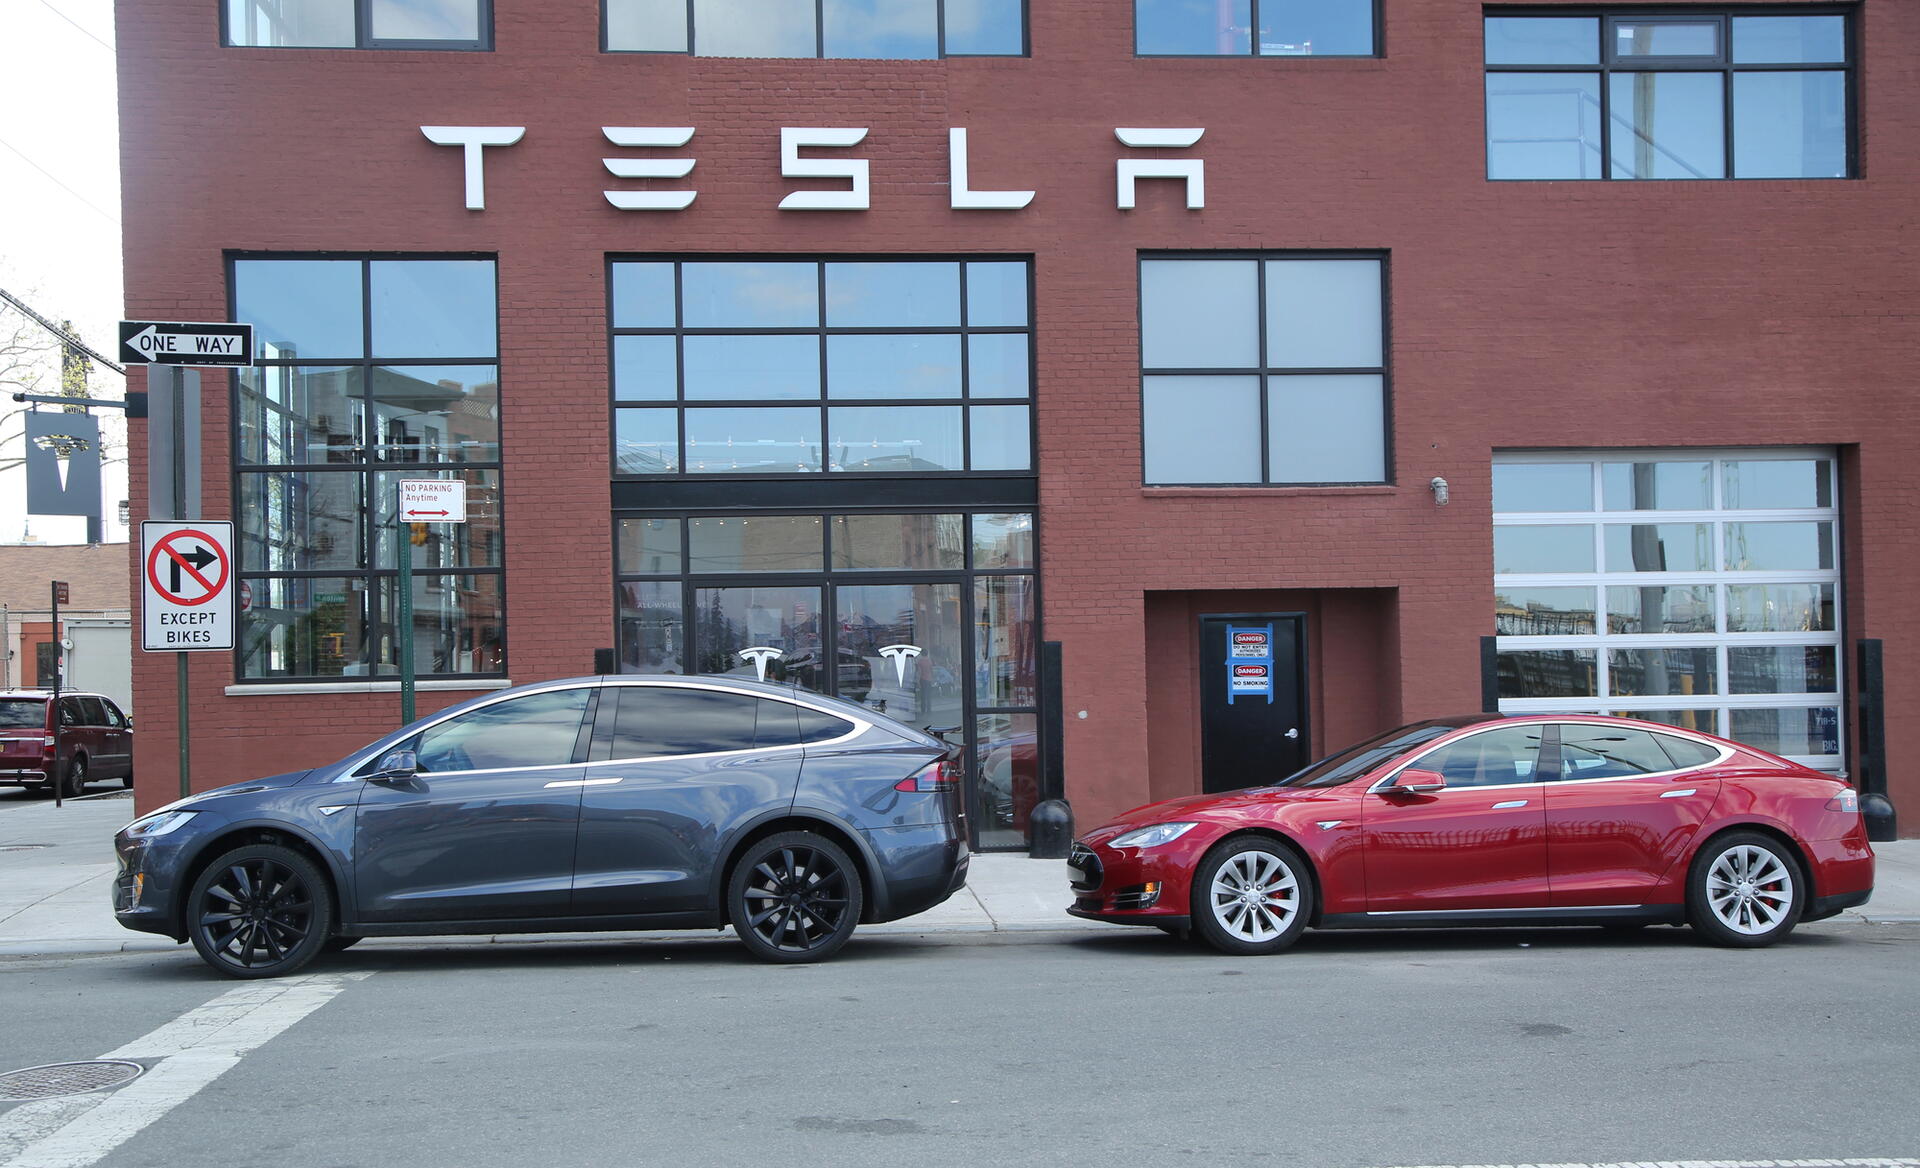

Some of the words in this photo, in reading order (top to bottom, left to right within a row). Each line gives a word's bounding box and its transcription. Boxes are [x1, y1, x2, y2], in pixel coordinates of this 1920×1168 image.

[419, 125, 1206, 211] TESLA
[140, 335, 177, 352] ONE
[195, 336, 235, 353] WAY
[405, 484, 416, 492] NO
[418, 484, 452, 492] PARKING
[406, 494, 438, 502] Anytime
[161, 612, 216, 624] EXCEPT
[167, 631, 210, 642] BIKES
